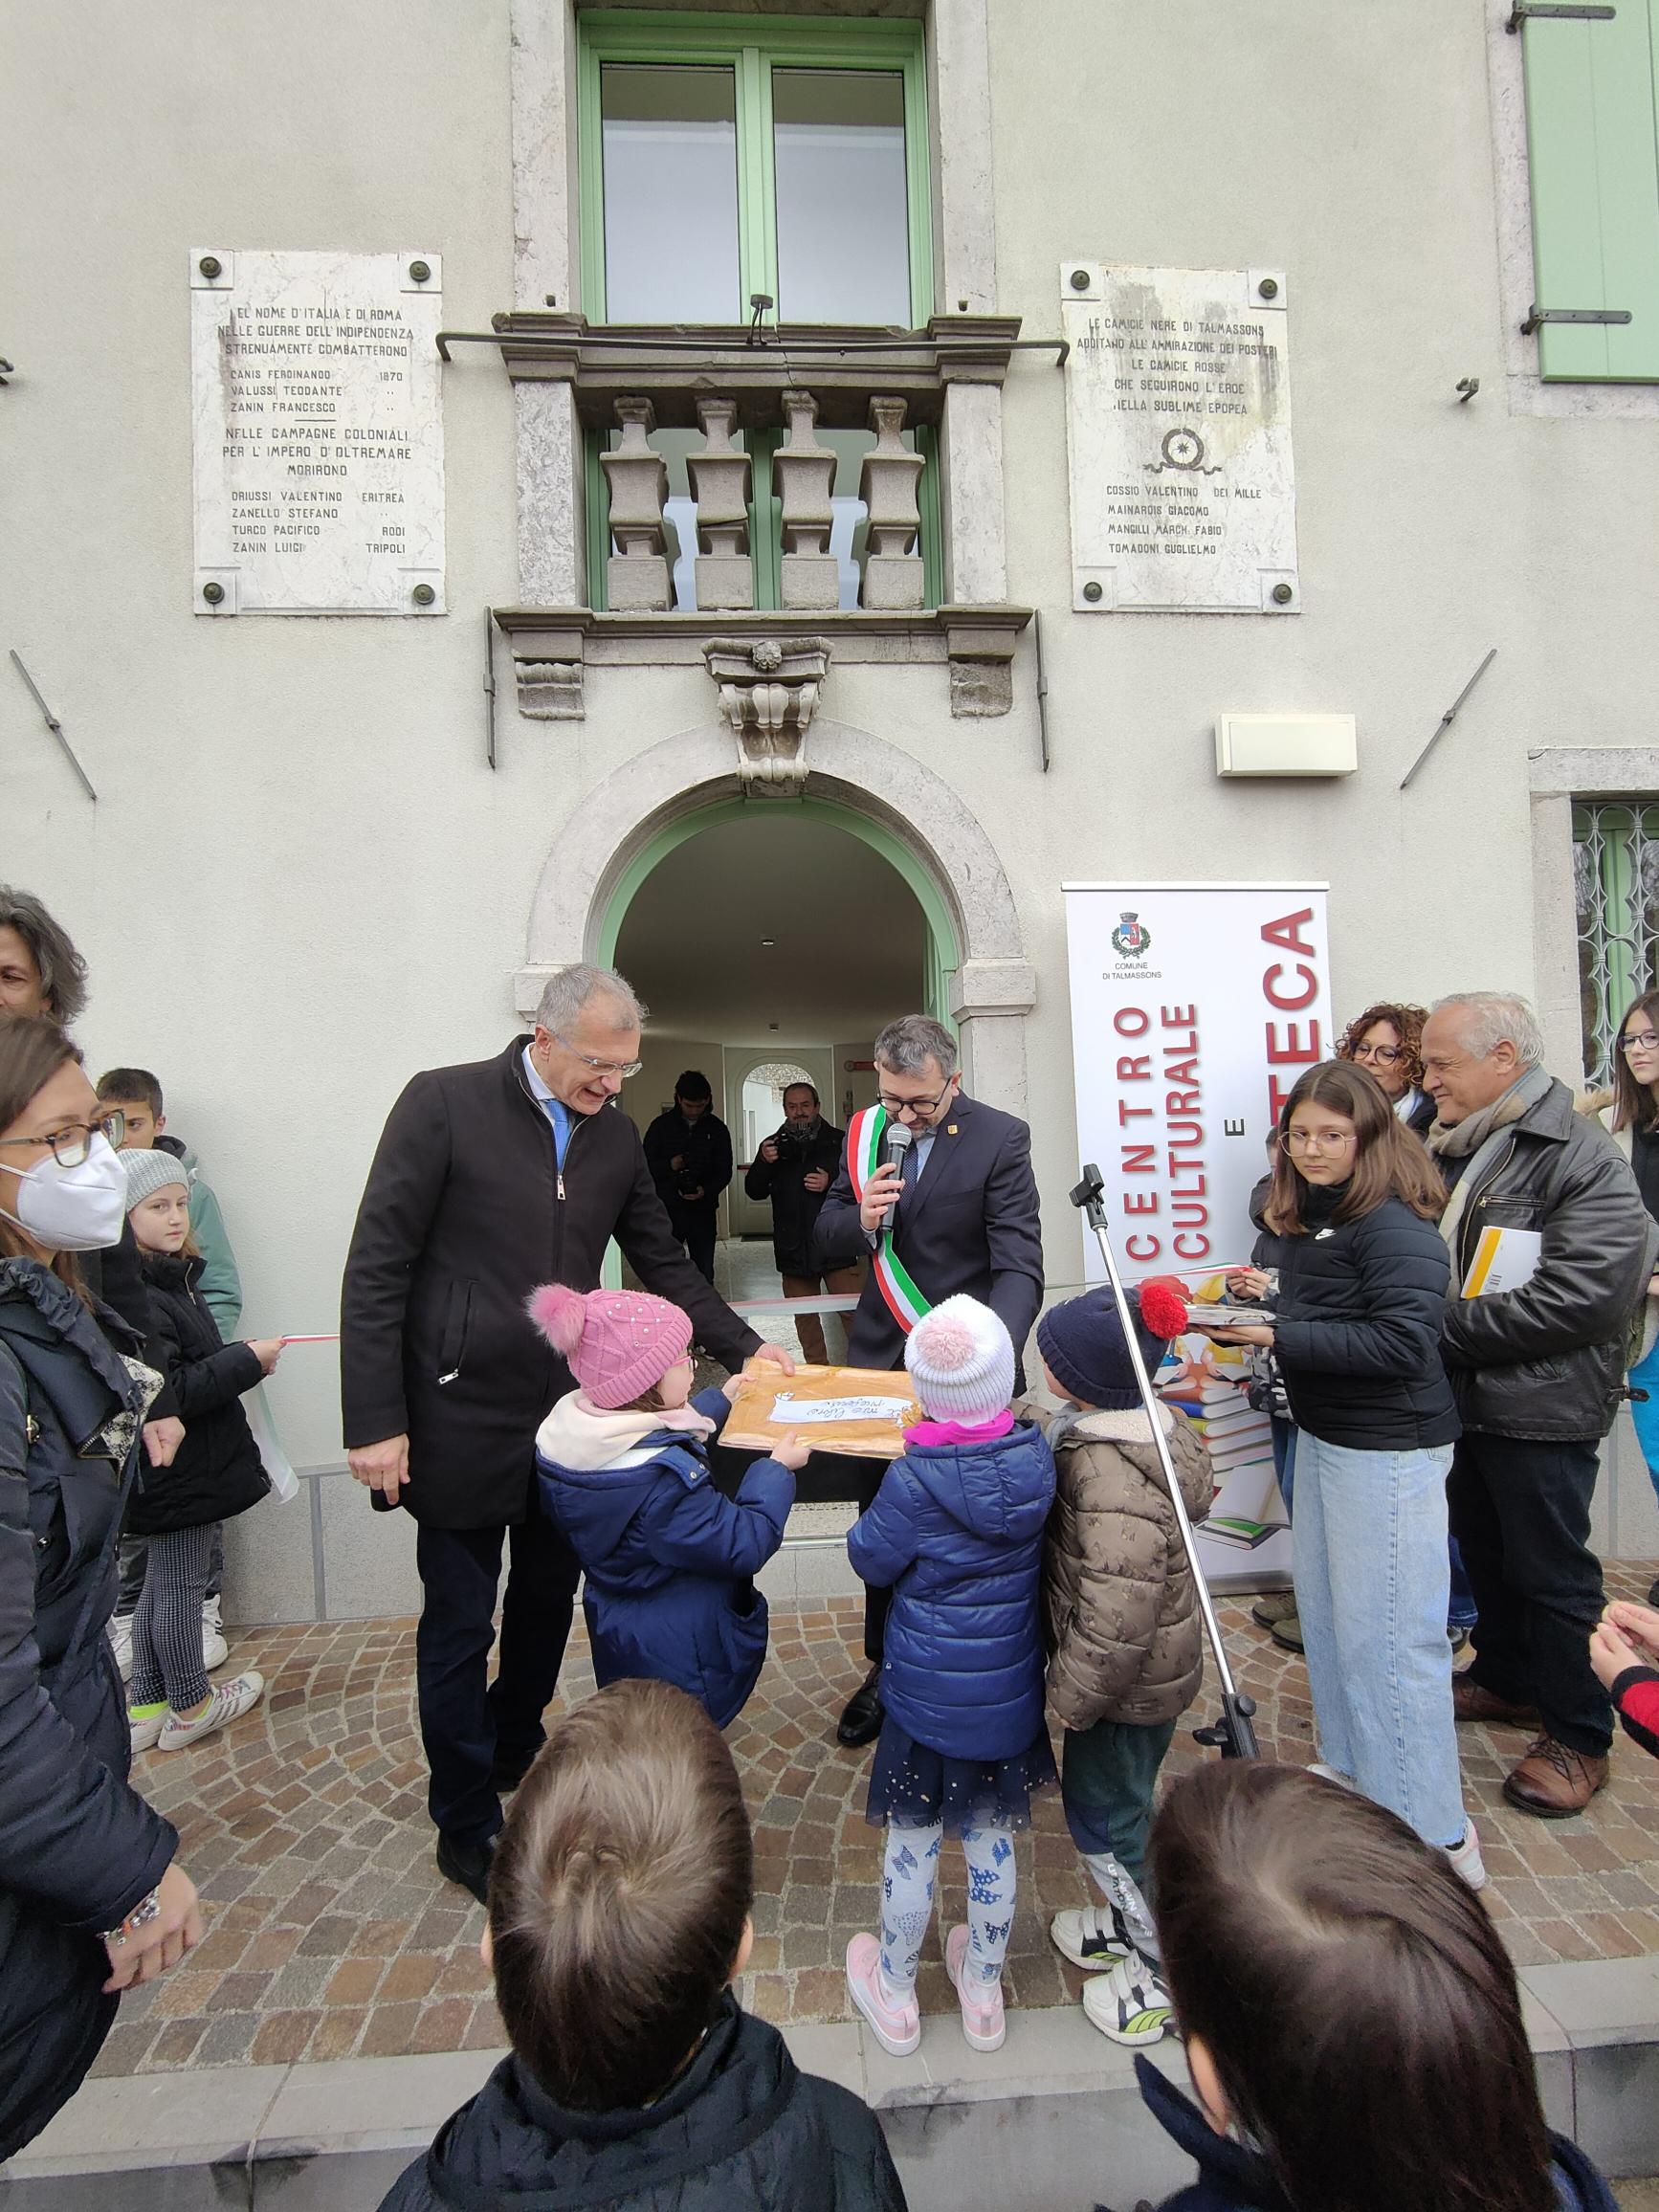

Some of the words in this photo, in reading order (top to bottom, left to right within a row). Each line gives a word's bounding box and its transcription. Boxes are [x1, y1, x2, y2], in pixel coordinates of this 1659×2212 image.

[255, 307, 286, 319] NOME
[291, 308, 340, 320] D'ITALIA
[346, 309, 350, 319] E
[357, 309, 365, 320] DI
[370, 309, 402, 321] ROMA
[218, 325, 253, 337] NELLE
[257, 325, 300, 337] GUERRE
[1089, 318, 1099, 329] LE
[1105, 319, 1143, 330] CAMICIE
[1151, 320, 1176, 331] NERE
[1183, 321, 1192, 332] DI
[1199, 321, 1264, 335] TALMASSONS
[225, 343, 313, 354] STRENUAMENTE
[319, 344, 407, 357] COMBATTERONO
[1077, 338, 1124, 349] ADDITANO
[1129, 339, 1147, 350] ALL'
[1152, 340, 1215, 353] AMMIRAZIONE
[1220, 343, 1234, 354] DEI
[1239, 344, 1277, 360] POSTERI
[1132, 360, 1143, 370] LE
[1150, 360, 1188, 371] CAMICIE
[1195, 362, 1226, 373] ROSSE
[231, 370, 261, 379] CANIS
[268, 370, 330, 379] FERDINANDO
[380, 372, 403, 381] 1870
[232, 387, 276, 396] VALUSSI
[284, 387, 342, 396] TEODANTE
[1115, 379, 1133, 390] CHE
[1140, 380, 1199, 392] SEGUIRONO
[1219, 383, 1244, 394] EROE
[231, 403, 264, 411] ZANIN
[273, 403, 335, 412] FRANCESCO
[1154, 401, 1202, 412] SUBLIME
[1208, 403, 1248, 414] EPOPEA
[226, 429, 262, 439] NELLE
[272, 429, 336, 439] CAMPAGNE
[344, 429, 409, 441] COLONIALI
[223, 447, 244, 457] PER
[267, 447, 311, 457] IMPERO
[336, 447, 411, 459] OLTREMARE
[287, 465, 347, 476] MORIRONO
[232, 492, 272, 501] DRIUSSI
[281, 492, 342, 502] VALENTINO
[362, 493, 405, 503] ERITREA
[1106, 486, 1139, 496] COSSIO
[1145, 487, 1198, 497] VALENTINO
[1214, 488, 1228, 498] DEI
[1234, 489, 1261, 498] MILLE
[232, 509, 280, 519] ZANELLO
[289, 509, 338, 519] STEFANO
[1108, 505, 1161, 515] MAINARDIS
[1168, 506, 1208, 516] GIACOMO
[232, 525, 266, 535] TURCO
[274, 525, 320, 535] PACIFICO
[383, 527, 405, 536] RODI
[1108, 524, 1149, 535] MANGILLI
[1195, 526, 1222, 536] FABIO
[233, 542, 267, 552] ZANIN
[276, 542, 302, 553] LUIGI
[365, 543, 405, 553] TRIPOLI
[1109, 543, 1159, 554] TOMADONI
[1164, 544, 1216, 554] GUGLIELMO
[1112, 971, 1162, 980] TALMASSONS
[1161, 1004, 1210, 1260] CULTURALE
[1224, 1118, 1244, 1136] E
[1114, 1007, 1161, 1261] CENTRO
